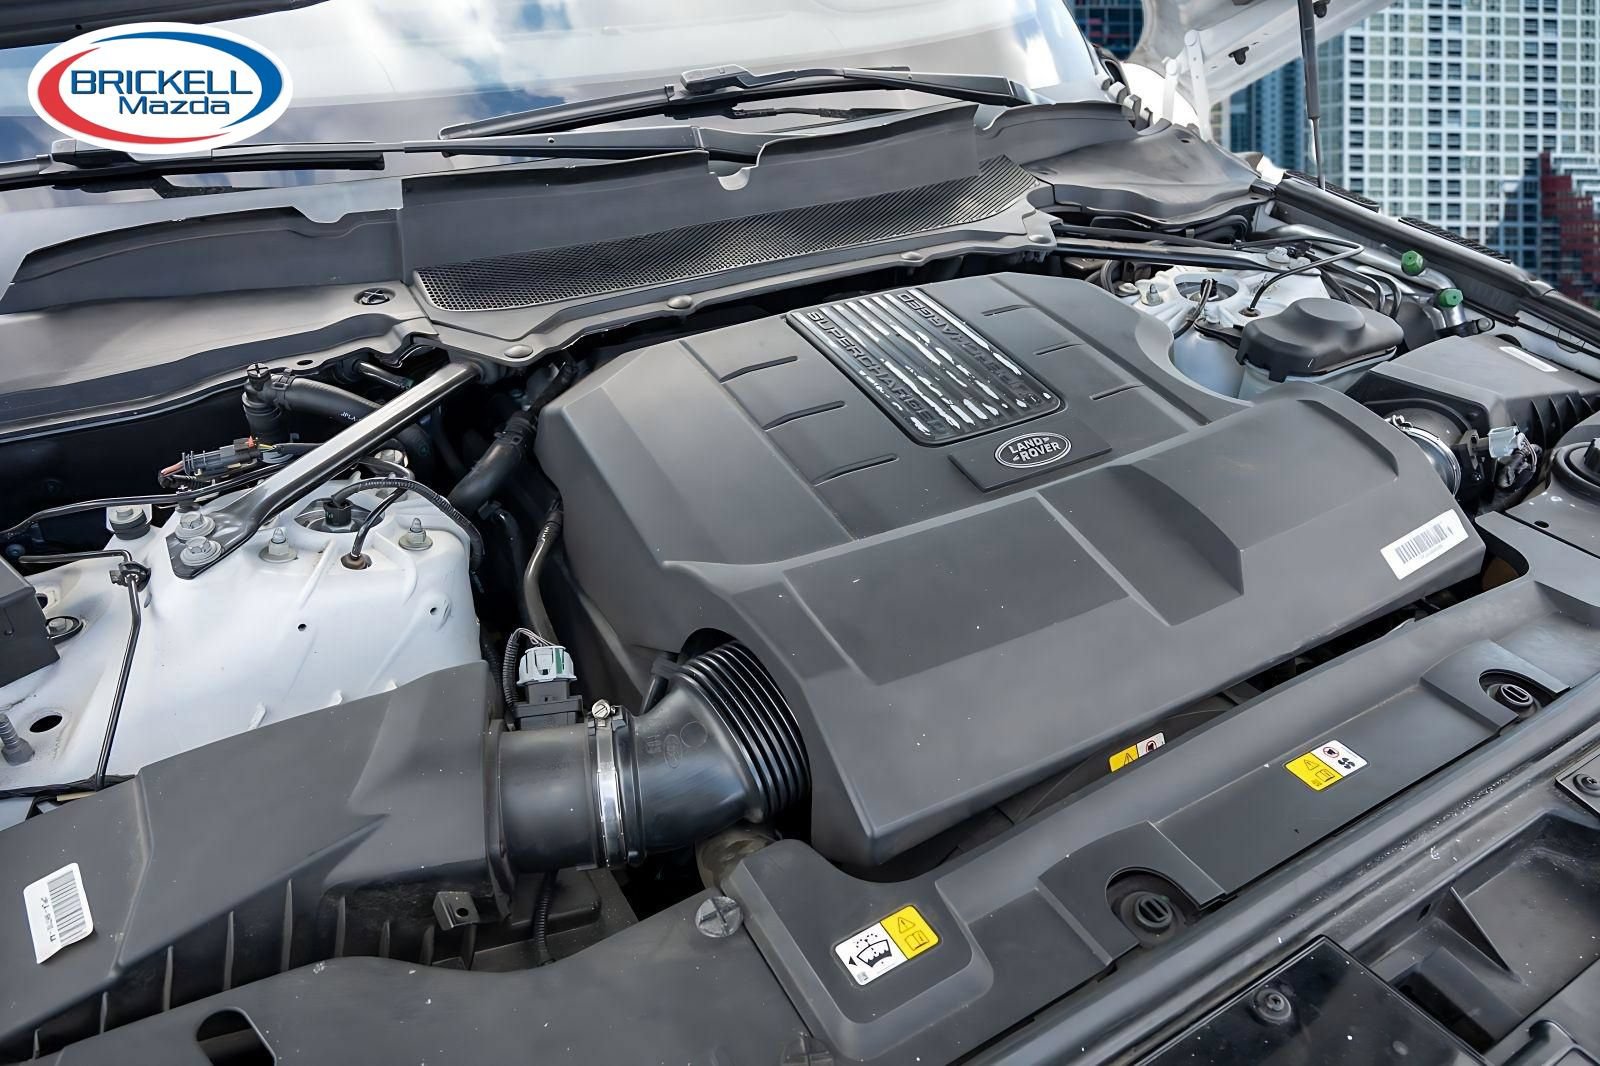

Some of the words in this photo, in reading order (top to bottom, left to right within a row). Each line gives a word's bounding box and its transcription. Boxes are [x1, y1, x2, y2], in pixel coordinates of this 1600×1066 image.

[808, 311, 948, 433] SUPERCHARGED
[1008, 437, 1043, 454] LAND
[1019, 442, 1061, 462] ROVER
